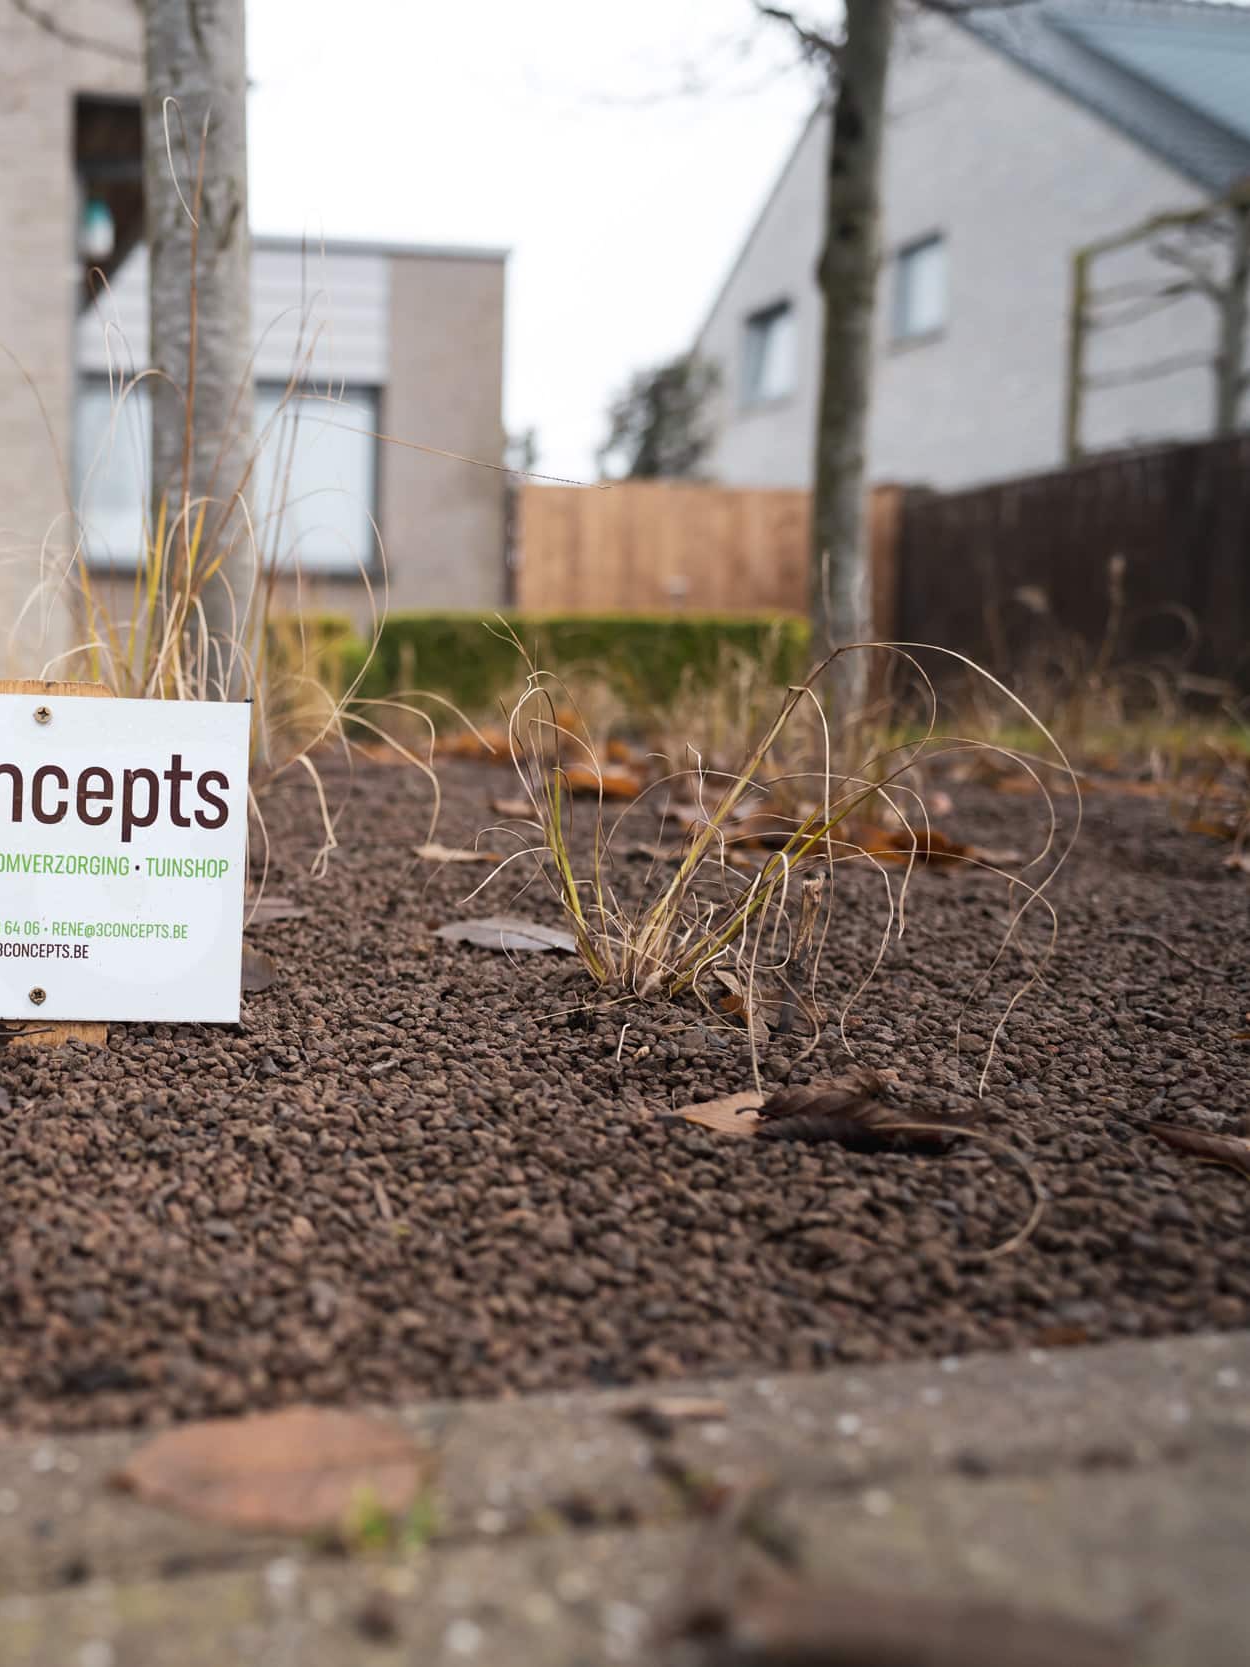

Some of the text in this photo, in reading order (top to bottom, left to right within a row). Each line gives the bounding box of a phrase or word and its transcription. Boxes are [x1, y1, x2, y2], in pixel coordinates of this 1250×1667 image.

[146, 857, 229, 879] TUINSHOP
[4, 919, 21, 935] 64
[24, 920, 40, 936] 06
[52, 922, 188, 939] RENE@3CONCEPTS.BE
